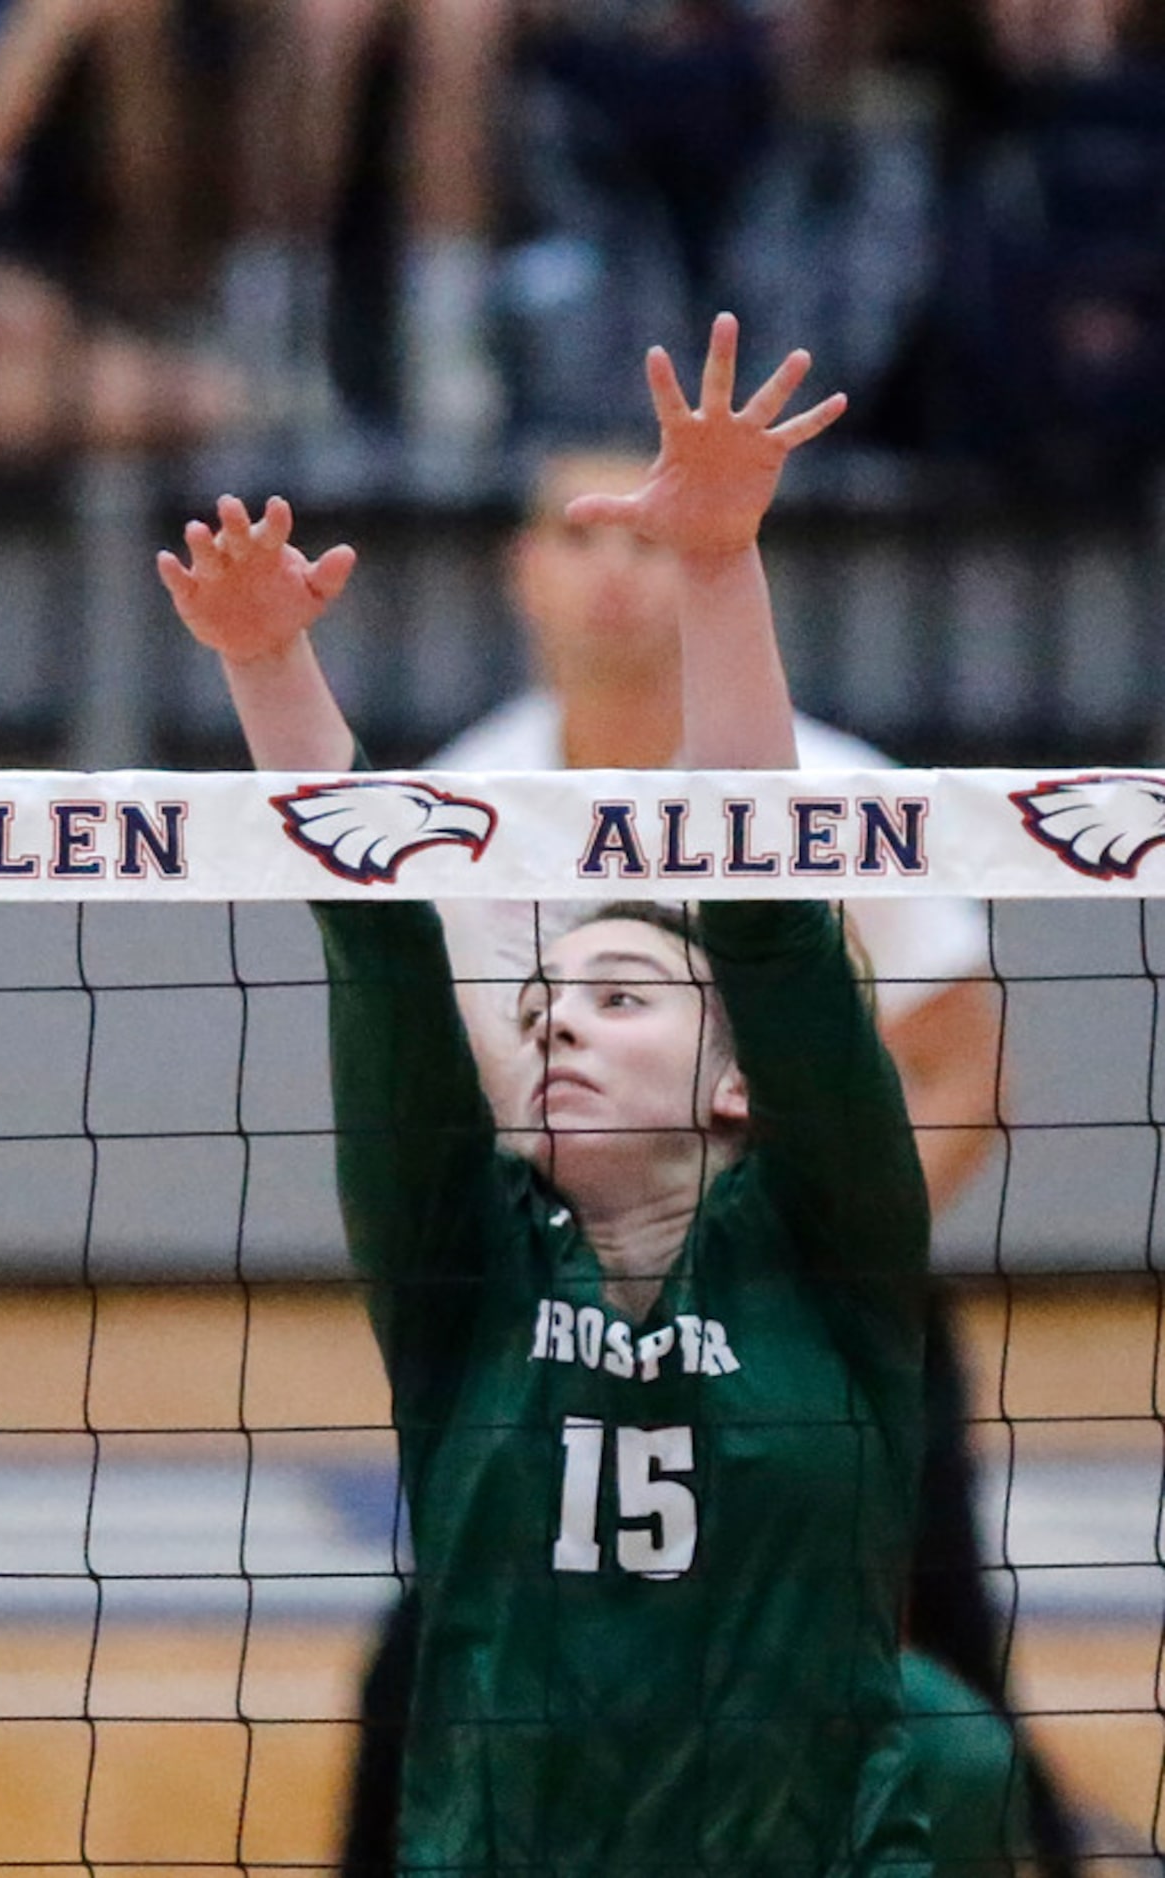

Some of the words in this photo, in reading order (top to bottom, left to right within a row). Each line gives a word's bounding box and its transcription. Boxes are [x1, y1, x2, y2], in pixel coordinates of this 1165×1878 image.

[577, 797, 928, 878] ALLEN
[527, 1299, 740, 1382] ROSPER
[553, 1415, 697, 1580] 15
